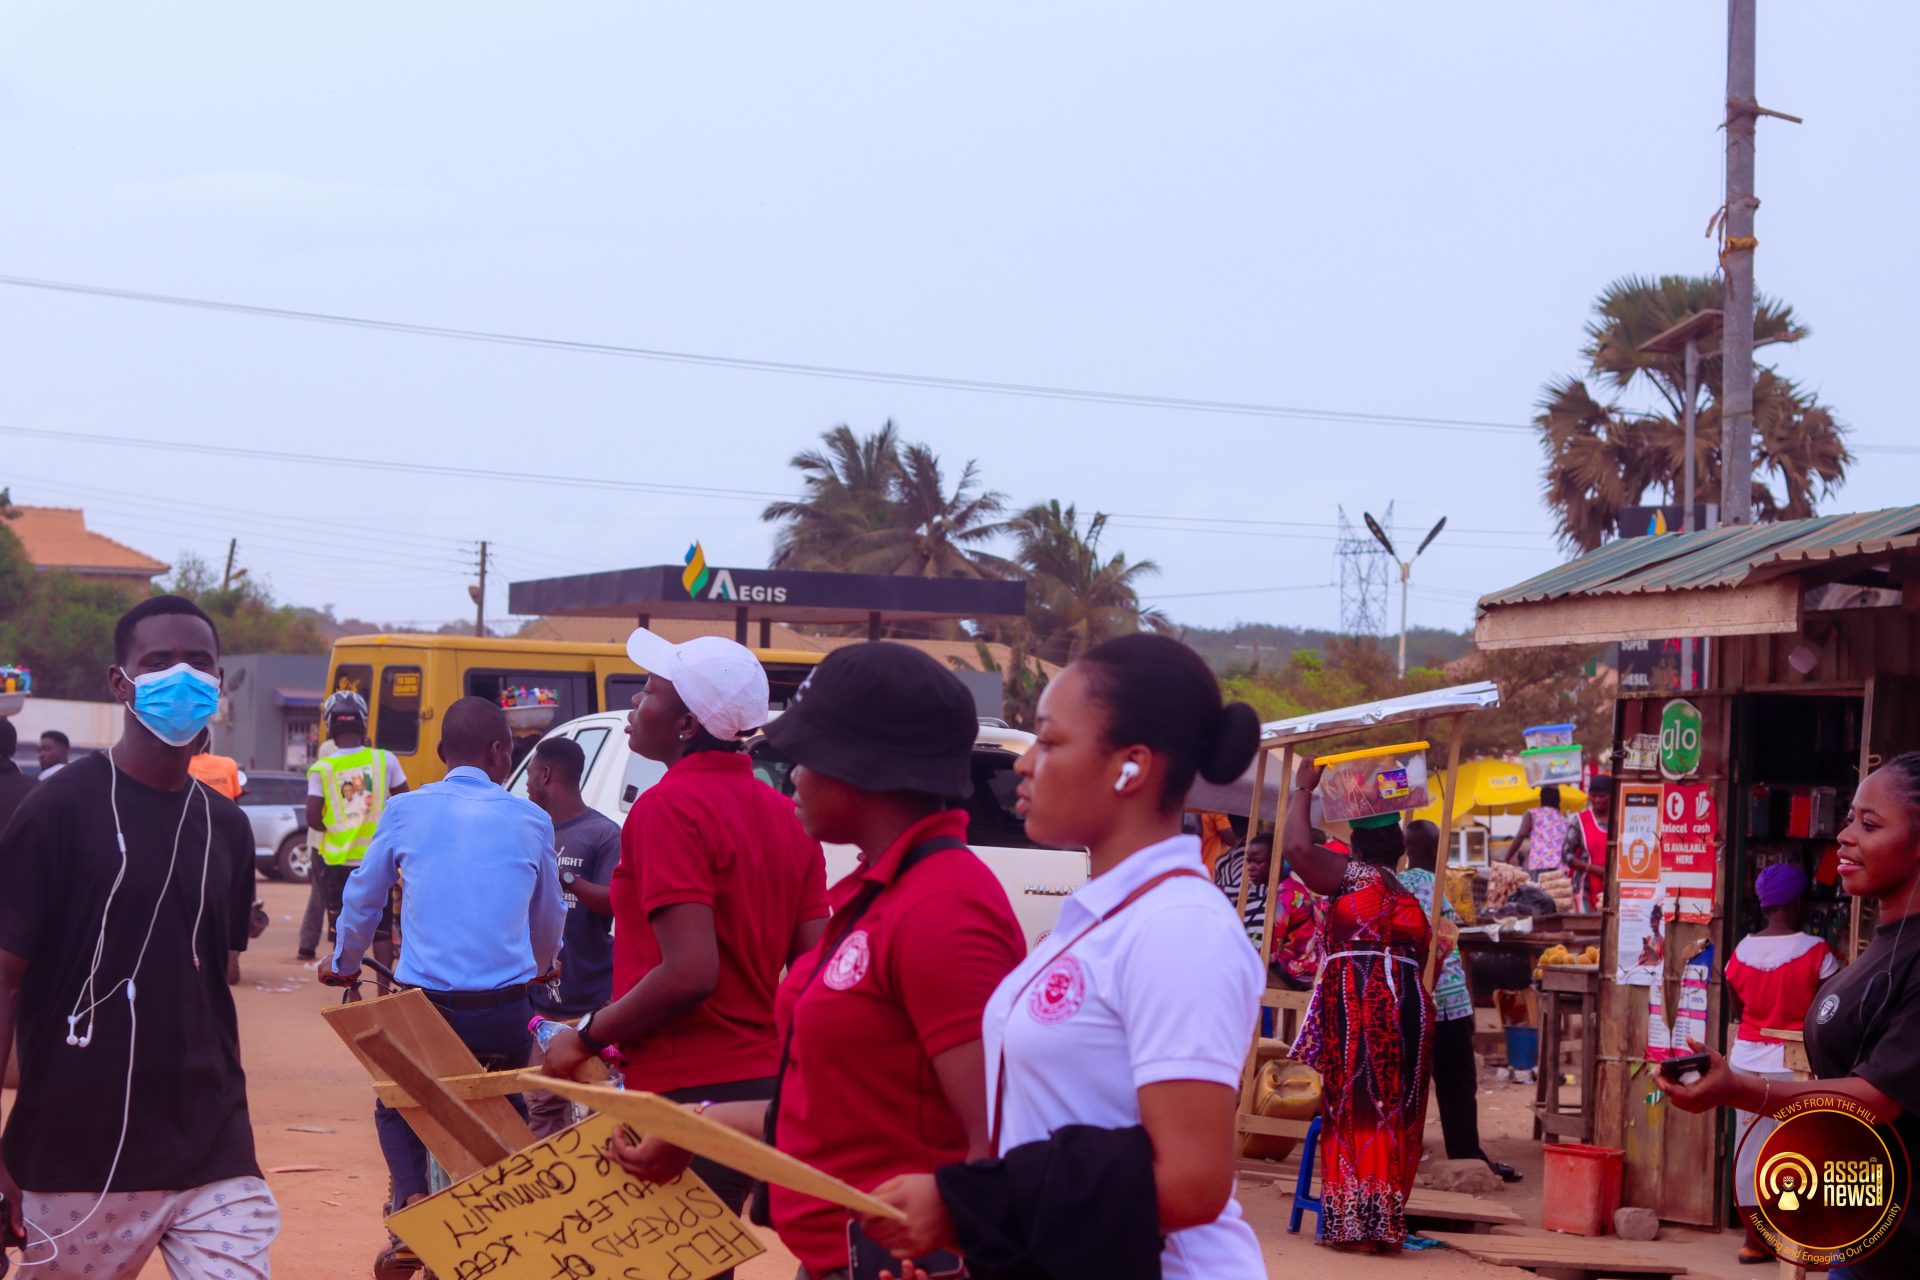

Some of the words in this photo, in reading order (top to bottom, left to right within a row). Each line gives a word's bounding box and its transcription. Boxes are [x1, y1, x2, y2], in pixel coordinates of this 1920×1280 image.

[708, 569, 787, 603] AEGIS
[1662, 719, 1697, 760] glo
[1693, 823, 1710, 833] cash
[1671, 843, 1707, 853] AVAILABLE
[1675, 854, 1694, 865] HERE
[451, 1128, 581, 1208] CLEAN
[443, 1161, 577, 1248] COMMUNITY
[591, 1186, 724, 1258] SPREAD
[551, 1253, 596, 1280] OF
[665, 1220, 762, 1280] HELP
